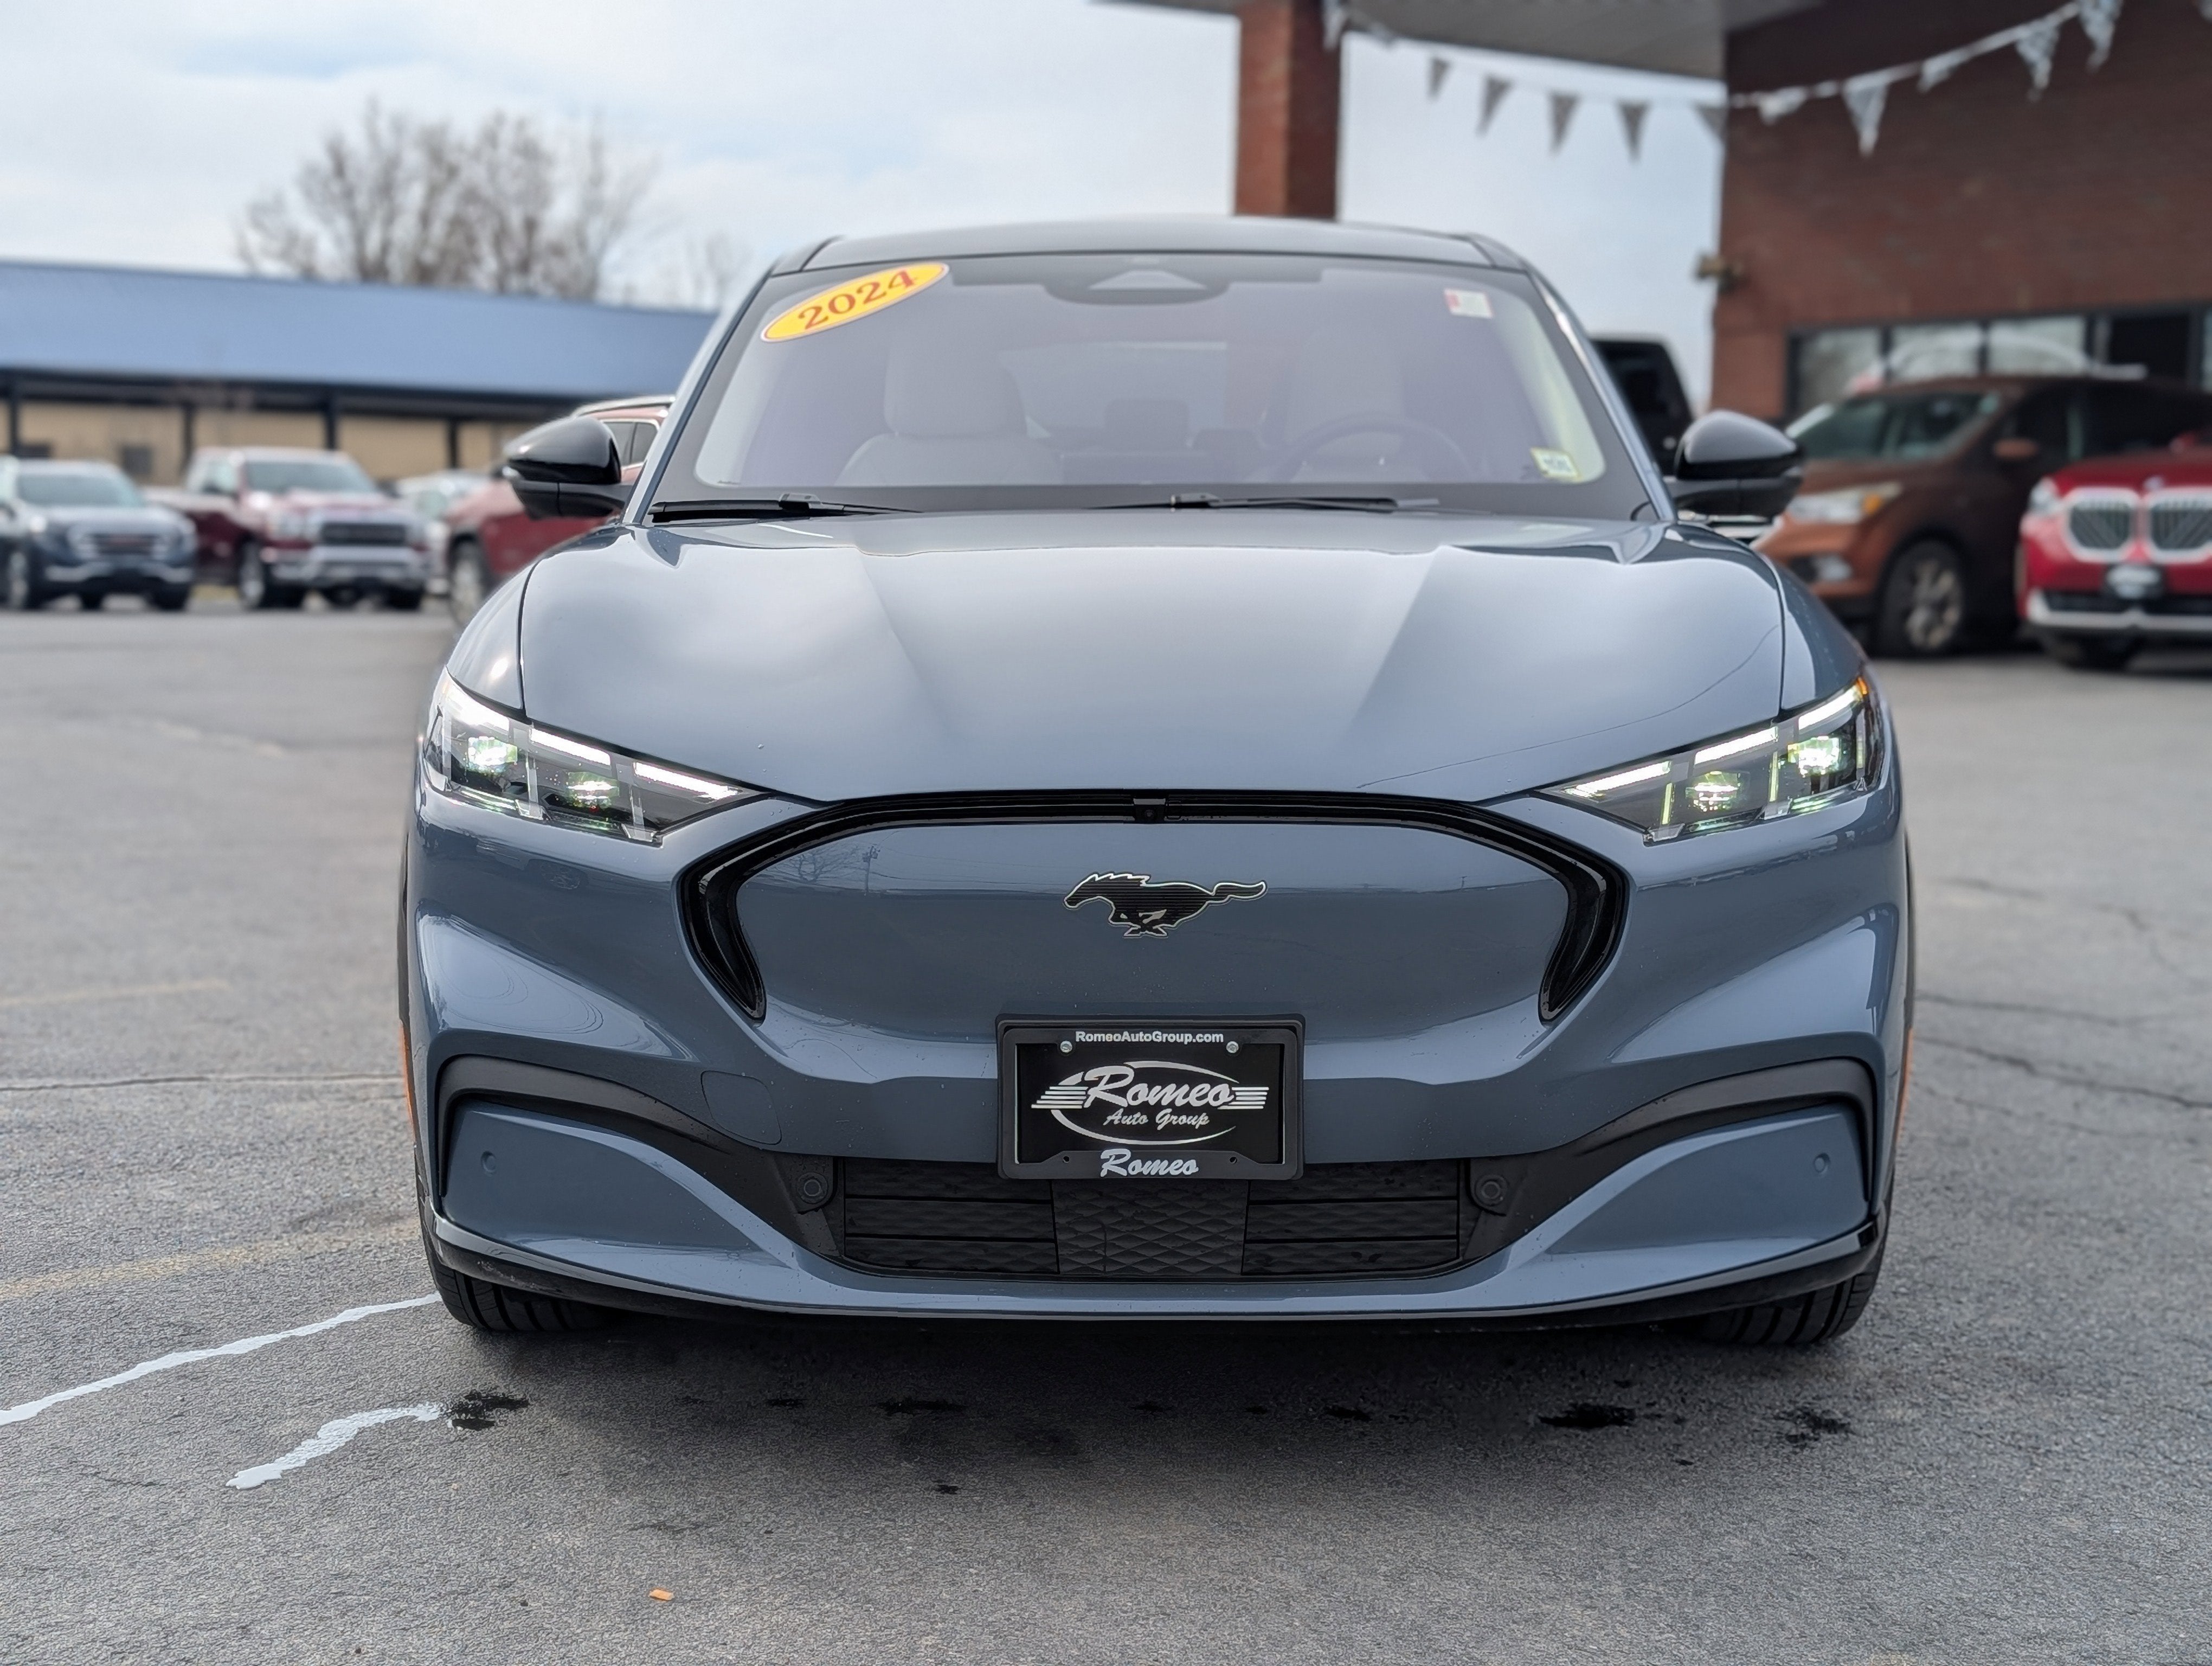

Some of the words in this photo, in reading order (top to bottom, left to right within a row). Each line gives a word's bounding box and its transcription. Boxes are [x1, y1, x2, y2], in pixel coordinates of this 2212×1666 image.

[799, 270, 917, 329] 2024
[1075, 1031, 1224, 1045] RomeoAutoGroup.com
[1084, 1065, 1235, 1108] Romeo
[1103, 1107, 1149, 1125] Auto
[1155, 1108, 1210, 1130] Group
[1100, 1148, 1199, 1177] Romeo
